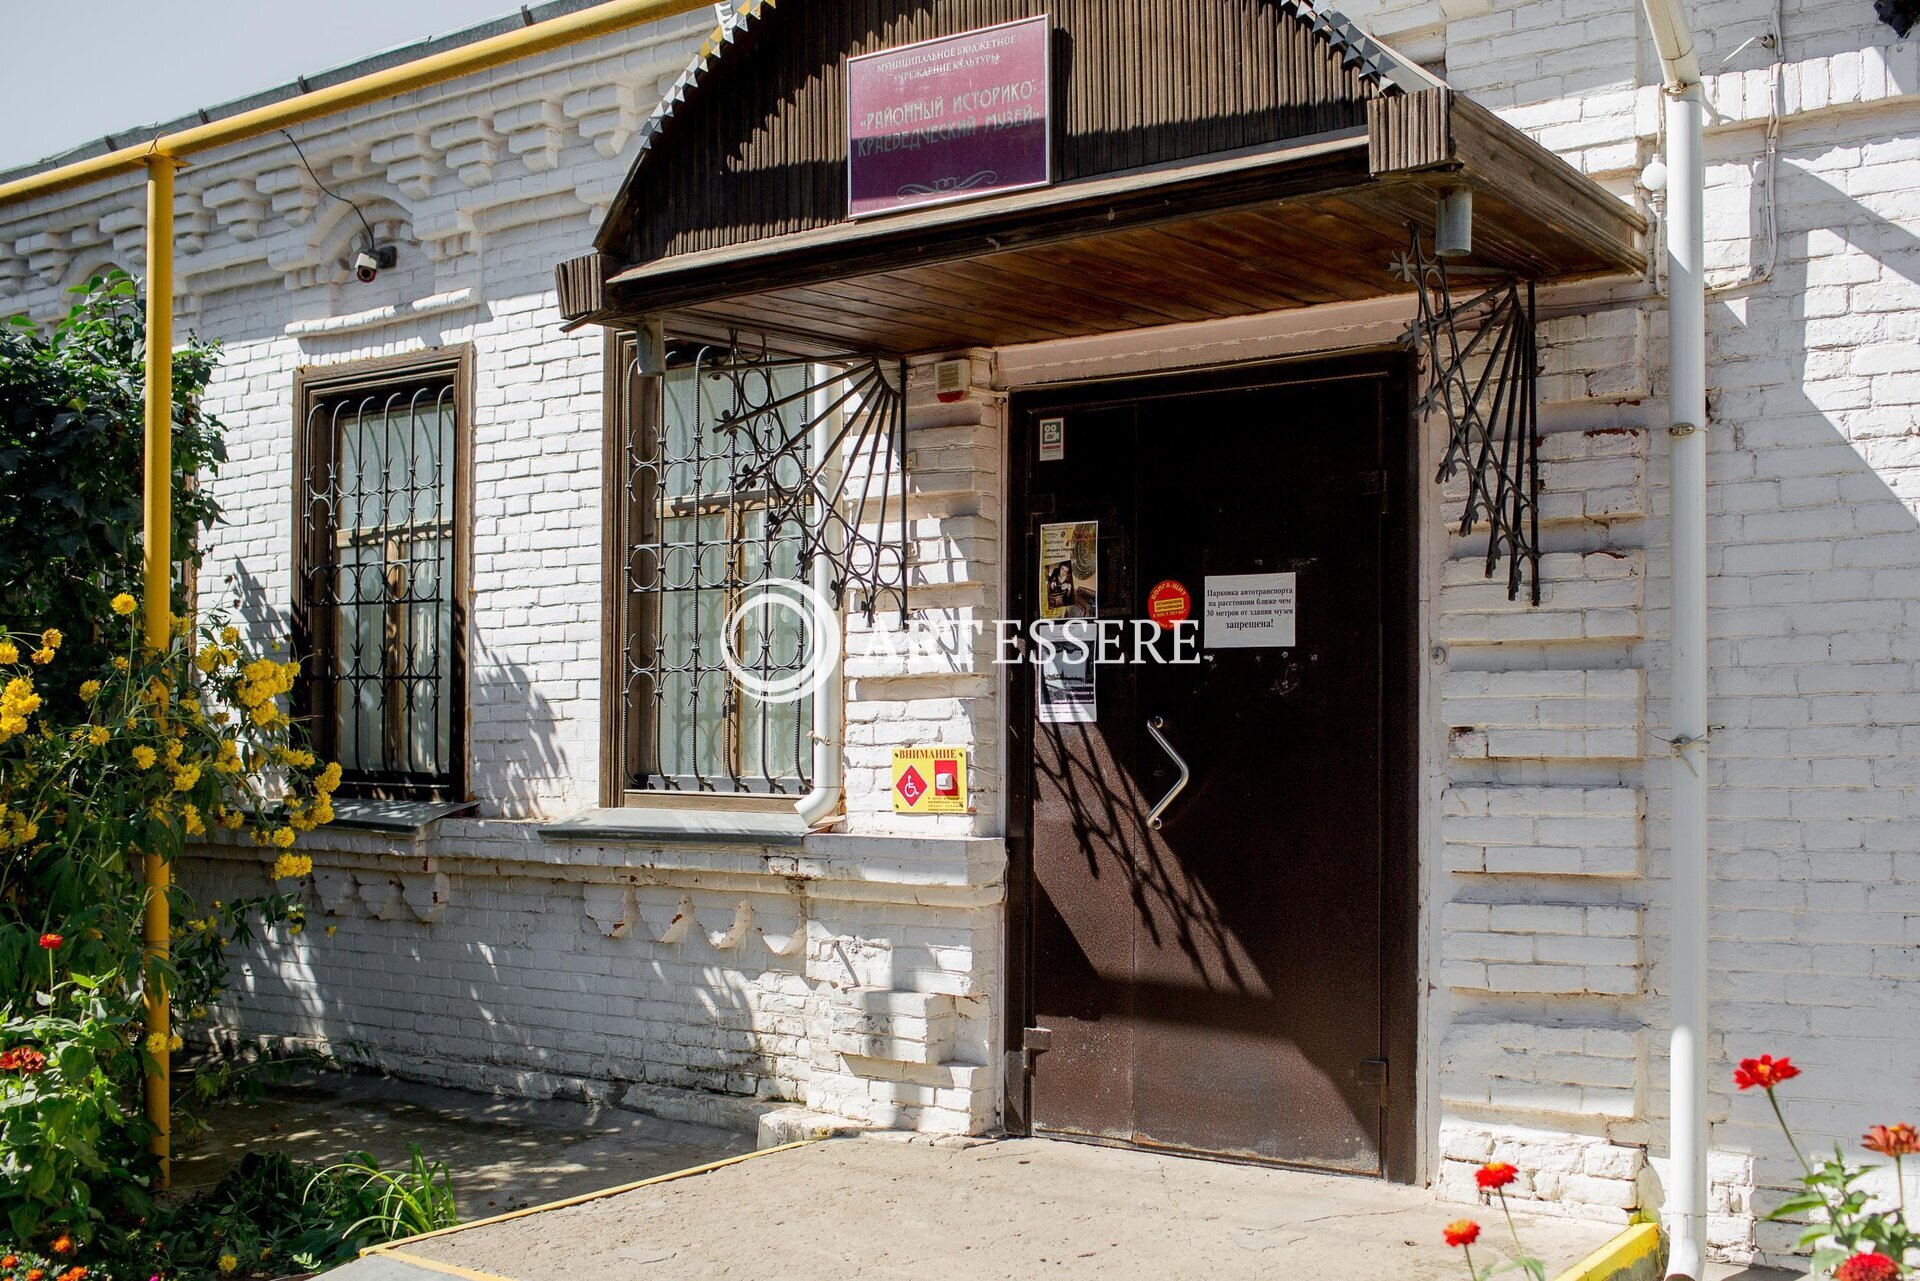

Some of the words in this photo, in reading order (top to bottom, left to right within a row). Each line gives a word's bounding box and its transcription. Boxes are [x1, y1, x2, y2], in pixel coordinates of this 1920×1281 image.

[877, 48, 955, 73] МУНИЦИПАЛЬНОЕ
[957, 35, 1016, 56] БЮДЖЕТНОЕ
[893, 62, 952, 82] УЧРЕЖДЕНИЕ
[858, 115, 976, 157] КРАЕВЕДЧЕСКИЙ
[1207, 589, 1239, 598] Парковка
[1240, 588, 1293, 596] автотранспорта
[1217, 600, 1255, 608] расстоянии
[1206, 609, 1214, 617] 30
[1215, 610, 1239, 618] метров
[1274, 608, 1293, 616] музея
[1225, 618, 1274, 631] запрещена!
[899, 749, 957, 759] ВНИМАНИЕ
